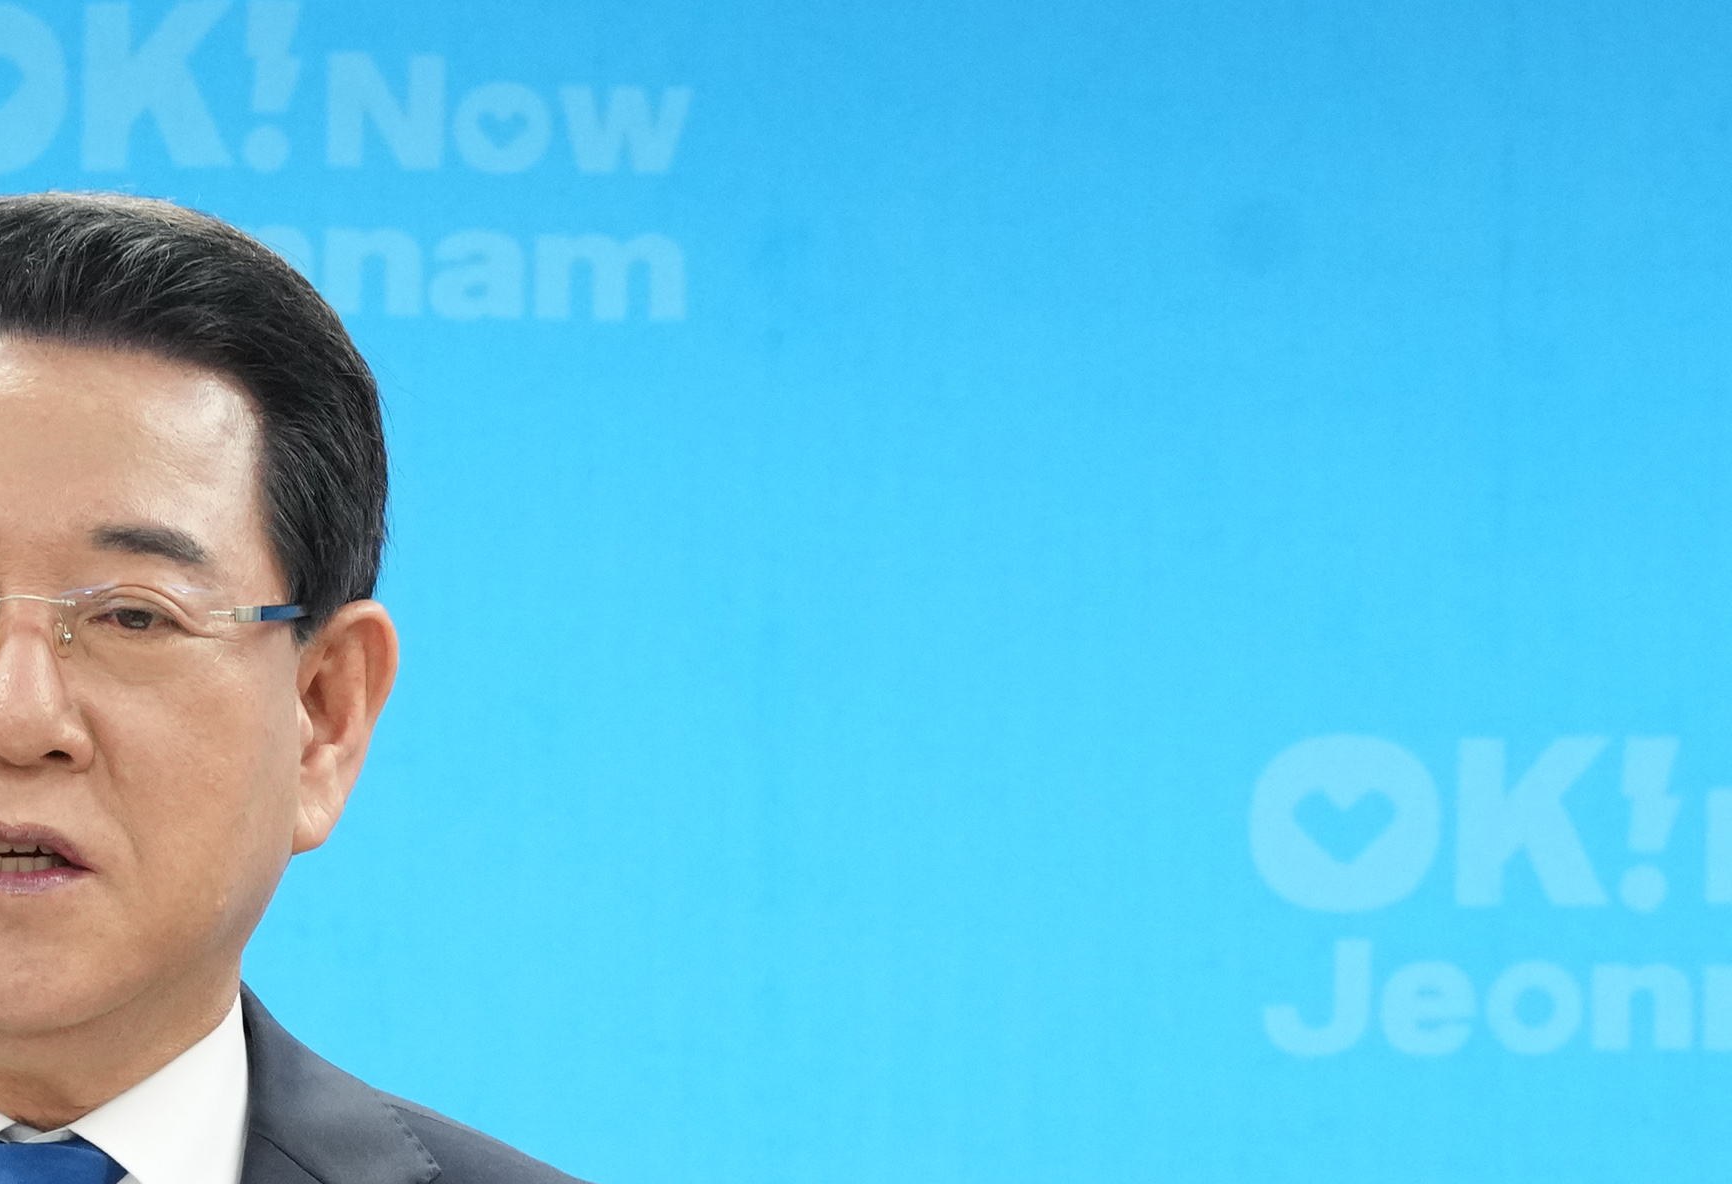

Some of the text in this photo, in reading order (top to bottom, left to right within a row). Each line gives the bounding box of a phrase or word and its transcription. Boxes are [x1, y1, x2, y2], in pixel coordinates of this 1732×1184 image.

[326, 50, 693, 174] Now
[1250, 733, 1680, 913] OK!
[1264, 938, 1732, 1058] Jeon
